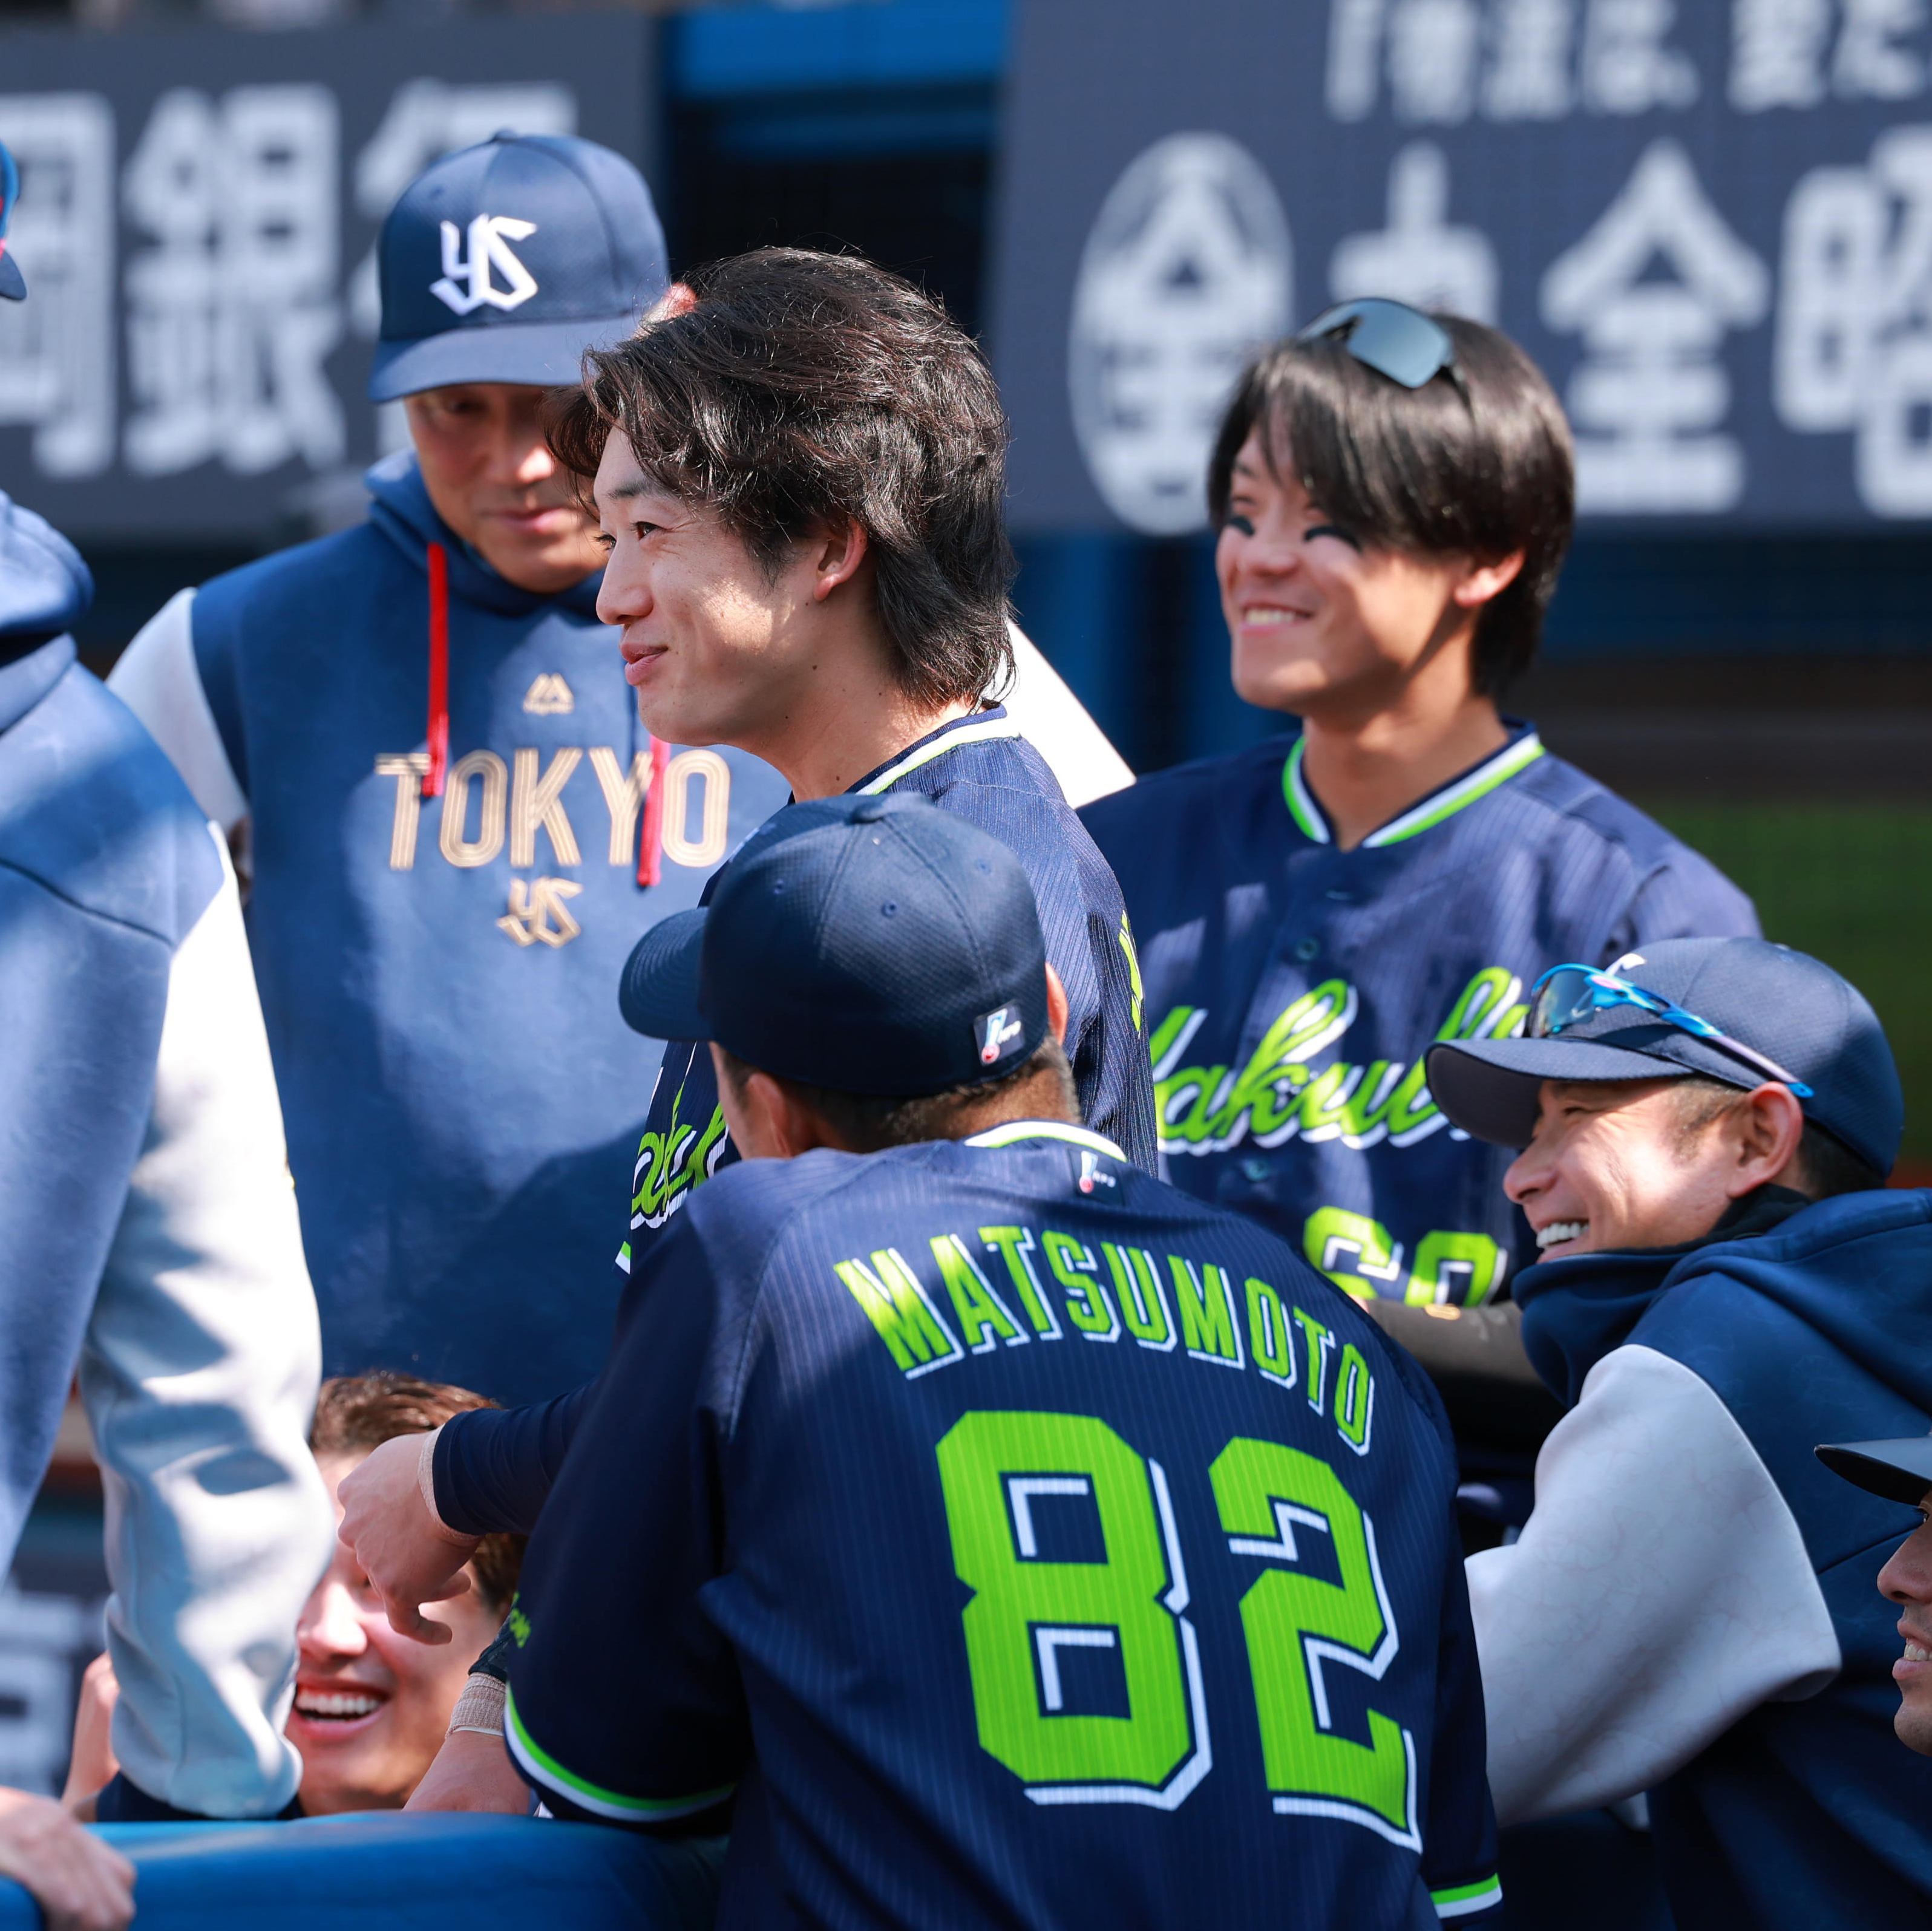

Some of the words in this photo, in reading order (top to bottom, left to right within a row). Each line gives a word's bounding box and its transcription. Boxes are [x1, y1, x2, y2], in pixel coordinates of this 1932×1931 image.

[374, 747, 732, 871] TOKYO
[833, 1226, 1375, 1457] MATSUMOTO
[935, 1410, 1423, 1855] 82
